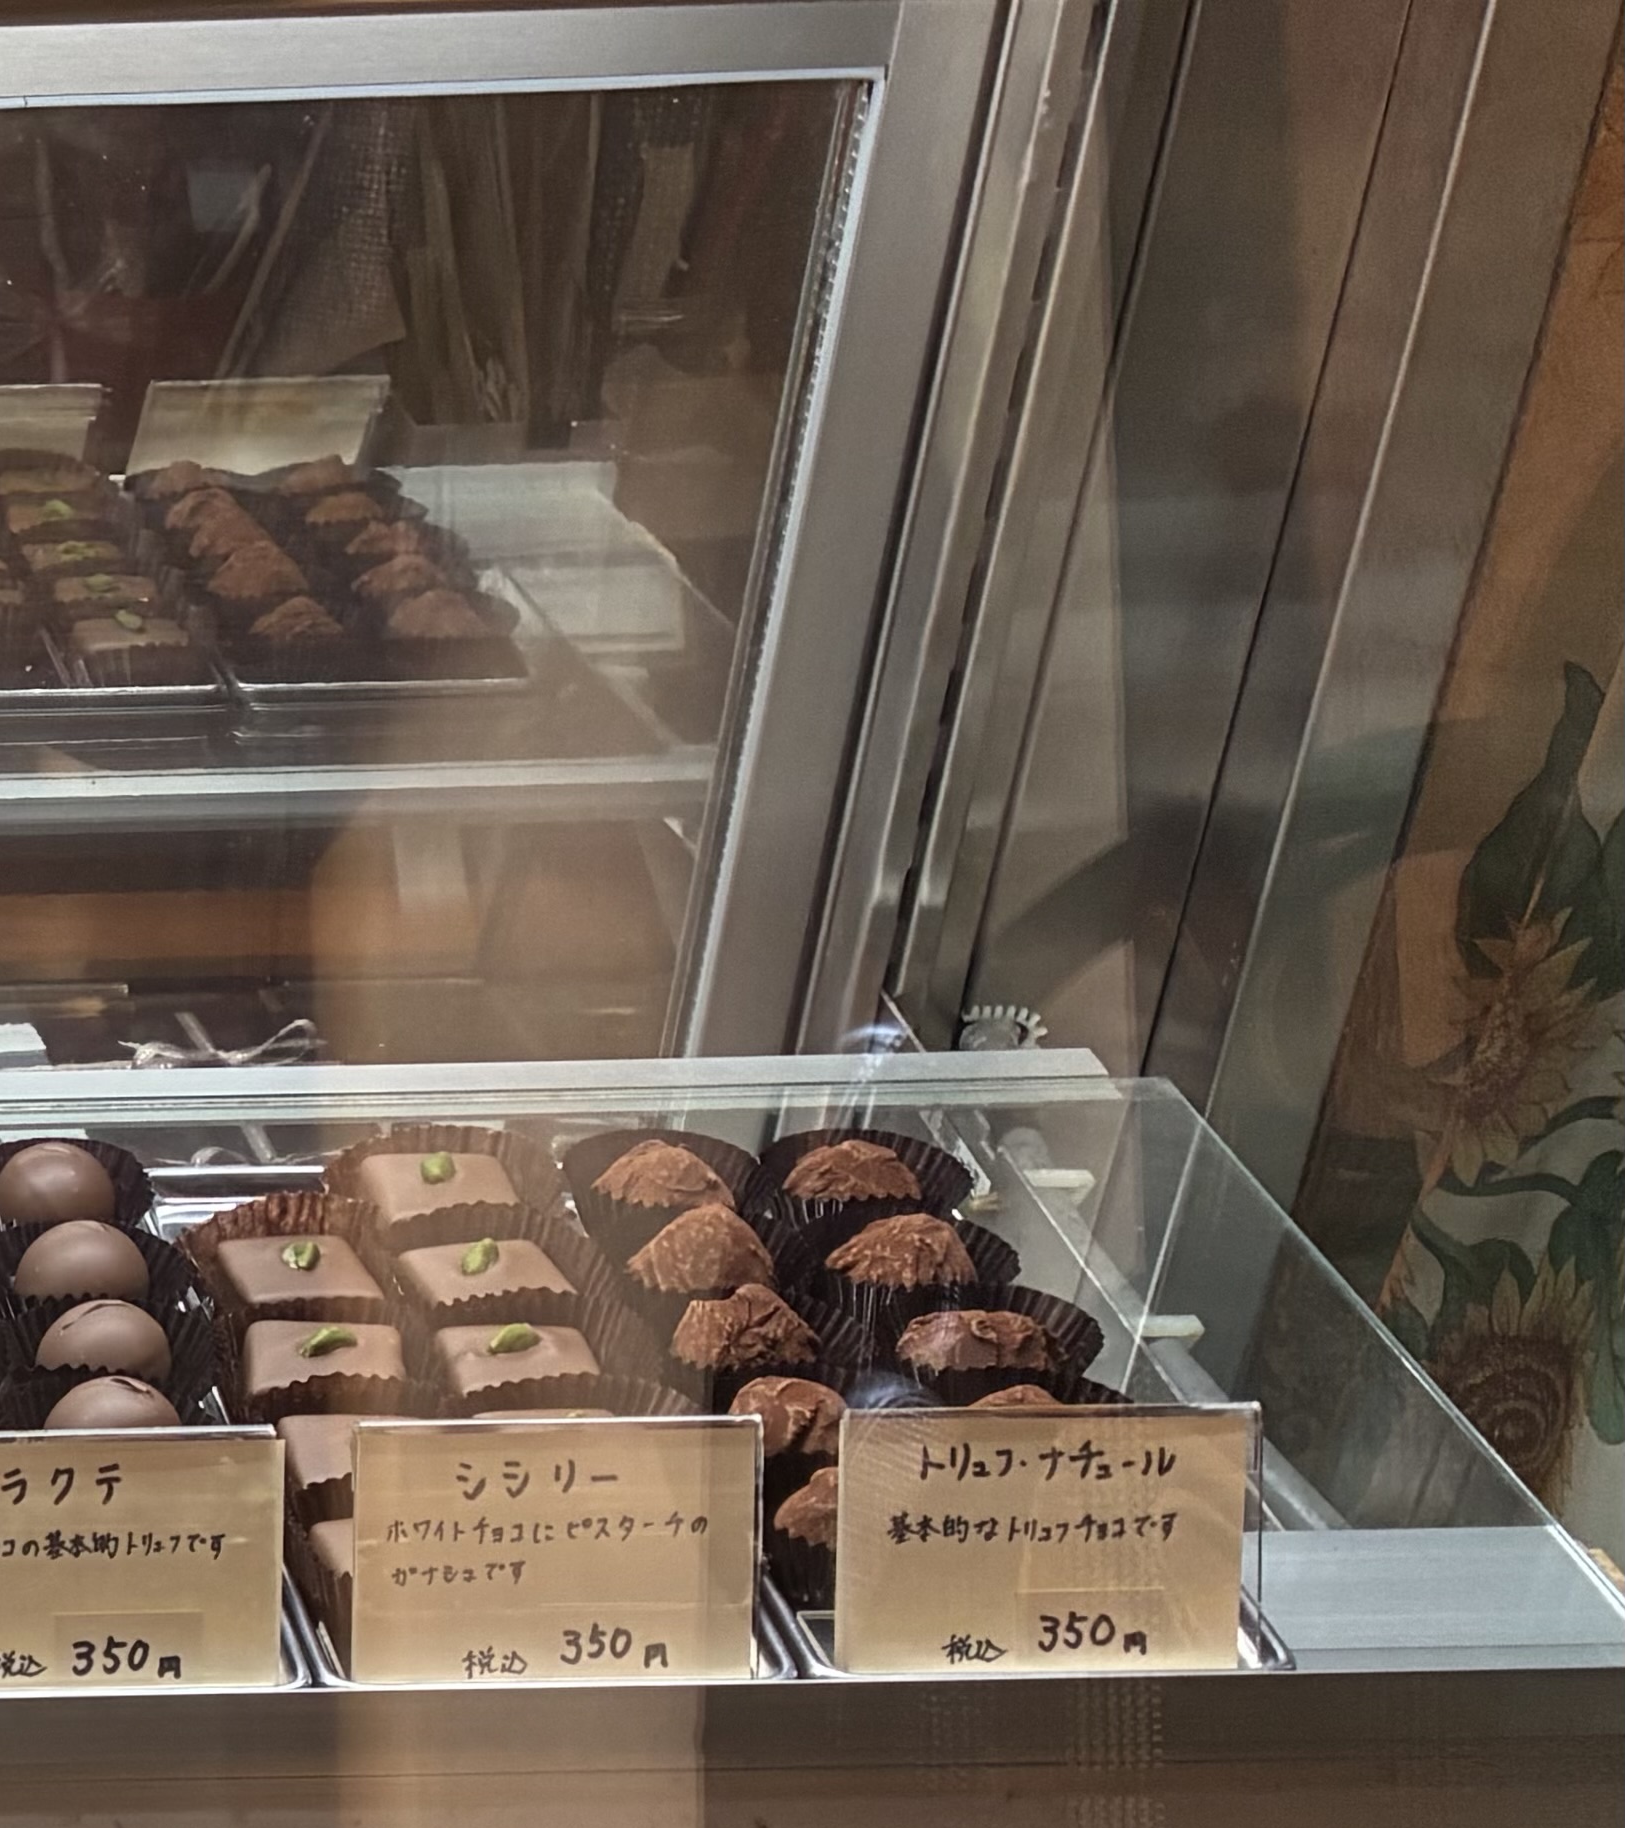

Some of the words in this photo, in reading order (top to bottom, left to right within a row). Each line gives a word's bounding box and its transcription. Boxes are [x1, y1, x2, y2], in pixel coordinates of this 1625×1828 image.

[0, 1463, 122, 1506] ラクテ
[455, 1459, 618, 1501] シシリー
[72, 1635, 181, 1679] 350円
[461, 1645, 528, 1680] 税込
[560, 1622, 669, 1669] 350円
[941, 1633, 1007, 1665] 税込
[1037, 1610, 1147, 1656] 350円
